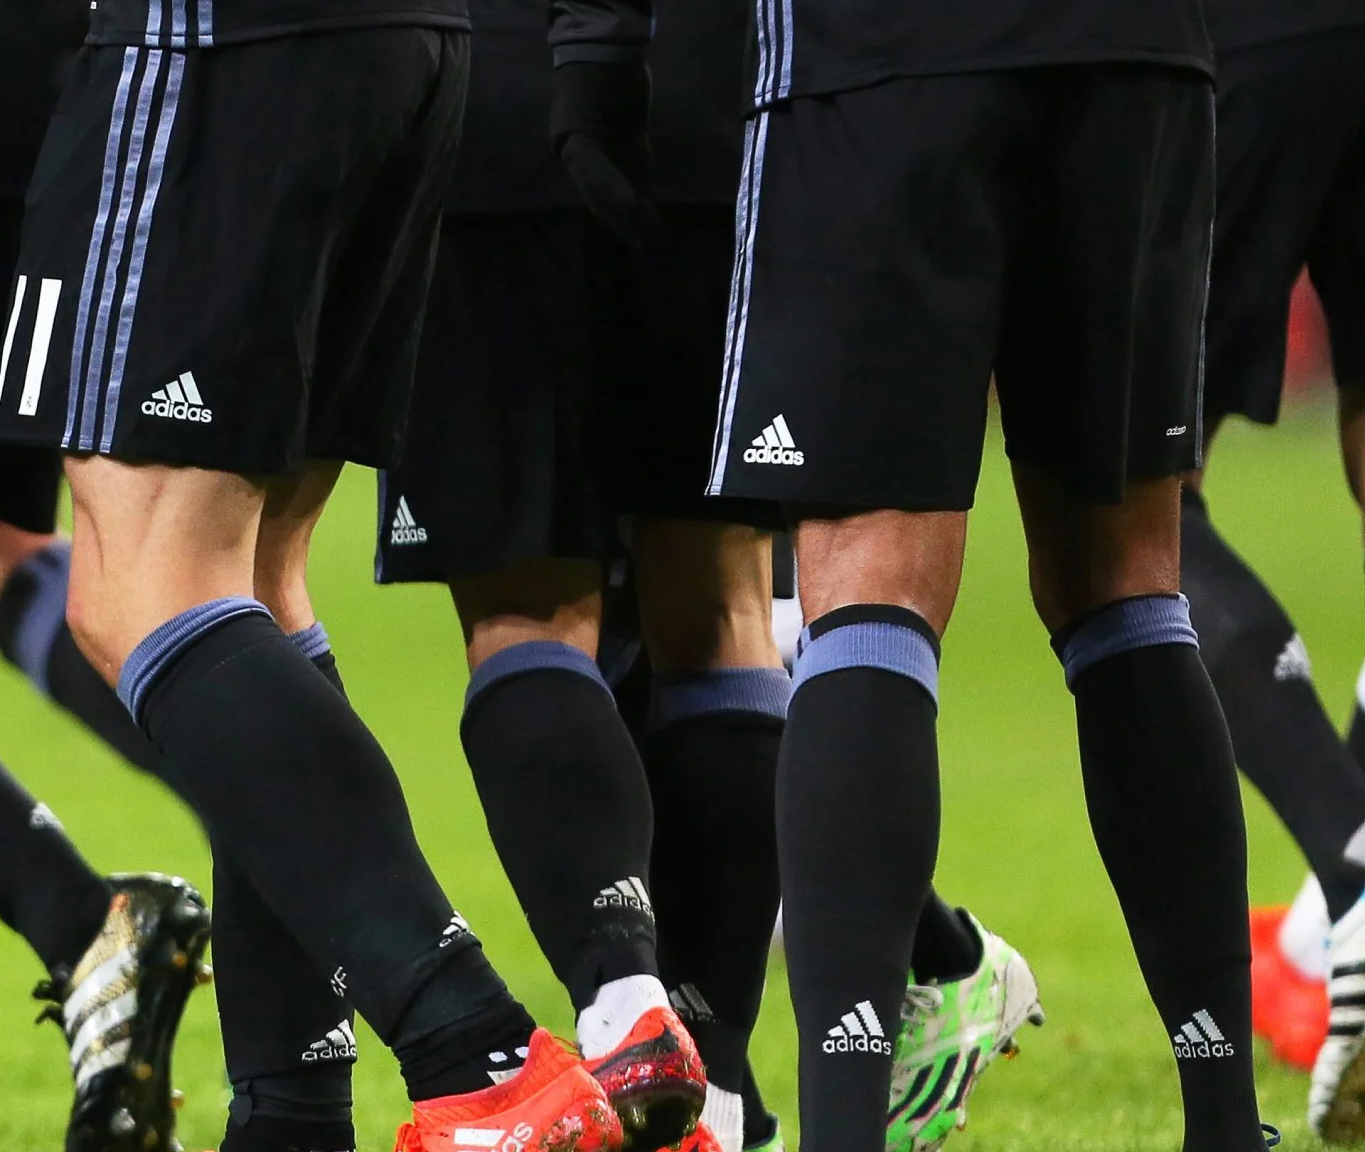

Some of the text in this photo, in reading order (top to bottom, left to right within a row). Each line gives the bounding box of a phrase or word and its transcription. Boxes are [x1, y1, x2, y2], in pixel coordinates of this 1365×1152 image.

[140, 397, 213, 424] adidas
[742, 445, 805, 466] adidas
[822, 1034, 892, 1056] adidas
[1174, 1041, 1235, 1058] adidas
